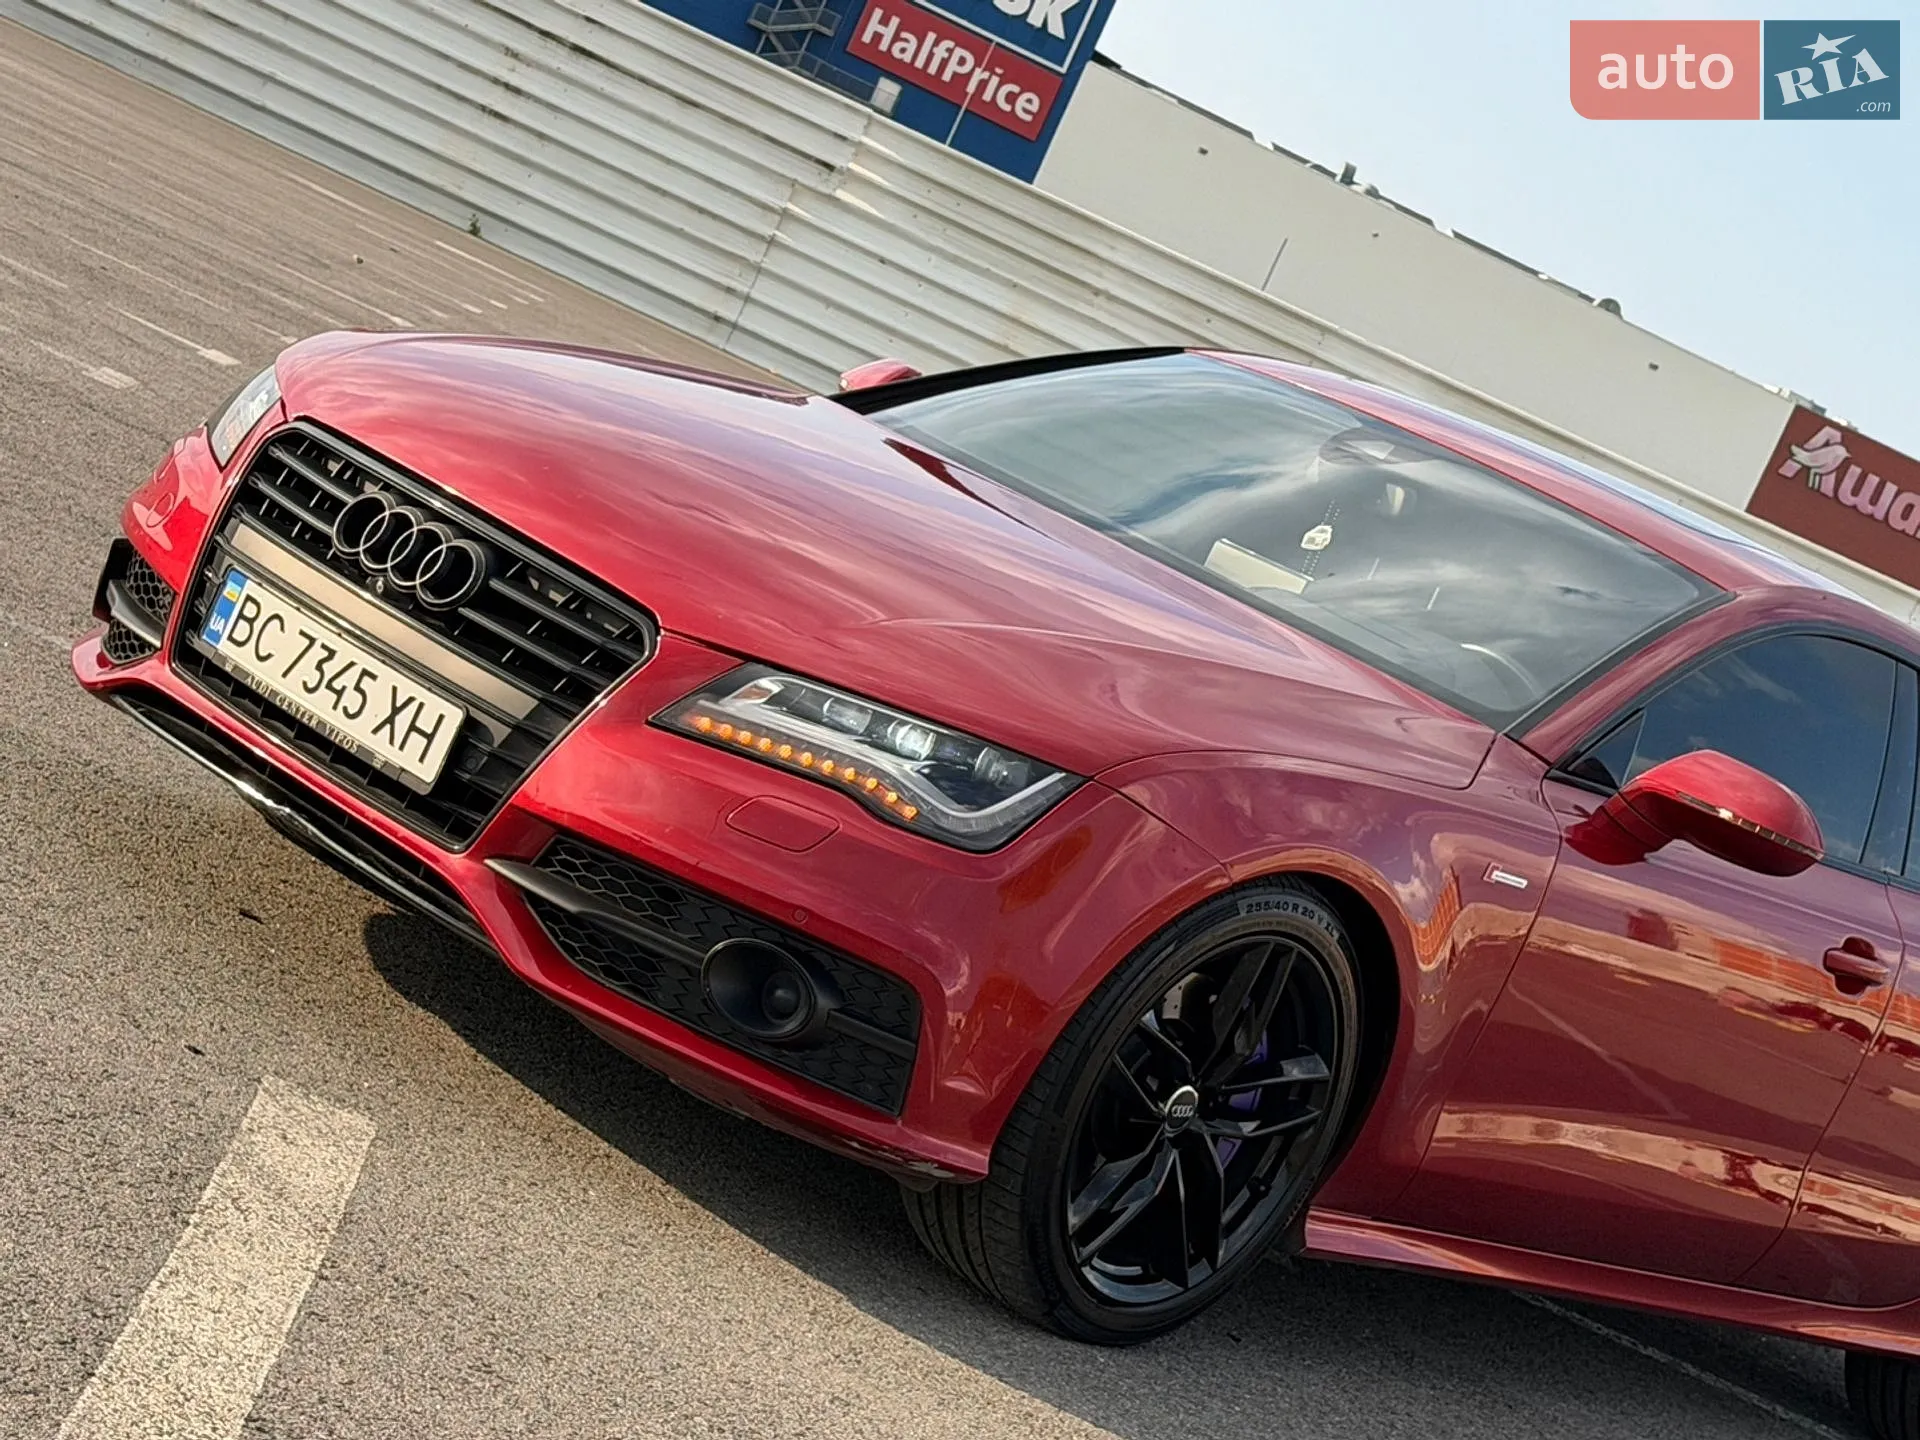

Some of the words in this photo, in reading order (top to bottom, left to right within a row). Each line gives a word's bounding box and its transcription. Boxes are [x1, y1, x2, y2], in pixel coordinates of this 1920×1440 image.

[861, 7, 1040, 122] HalfPrice
[209, 612, 225, 635] UA
[227, 594, 285, 663] BC
[281, 629, 379, 720] 7345
[371, 685, 446, 765] XH
[244, 672, 273, 697] AUDI
[277, 690, 321, 728] CENTER
[1291, 902, 1300, 913] R
[1301, 906, 1315, 920] 20
